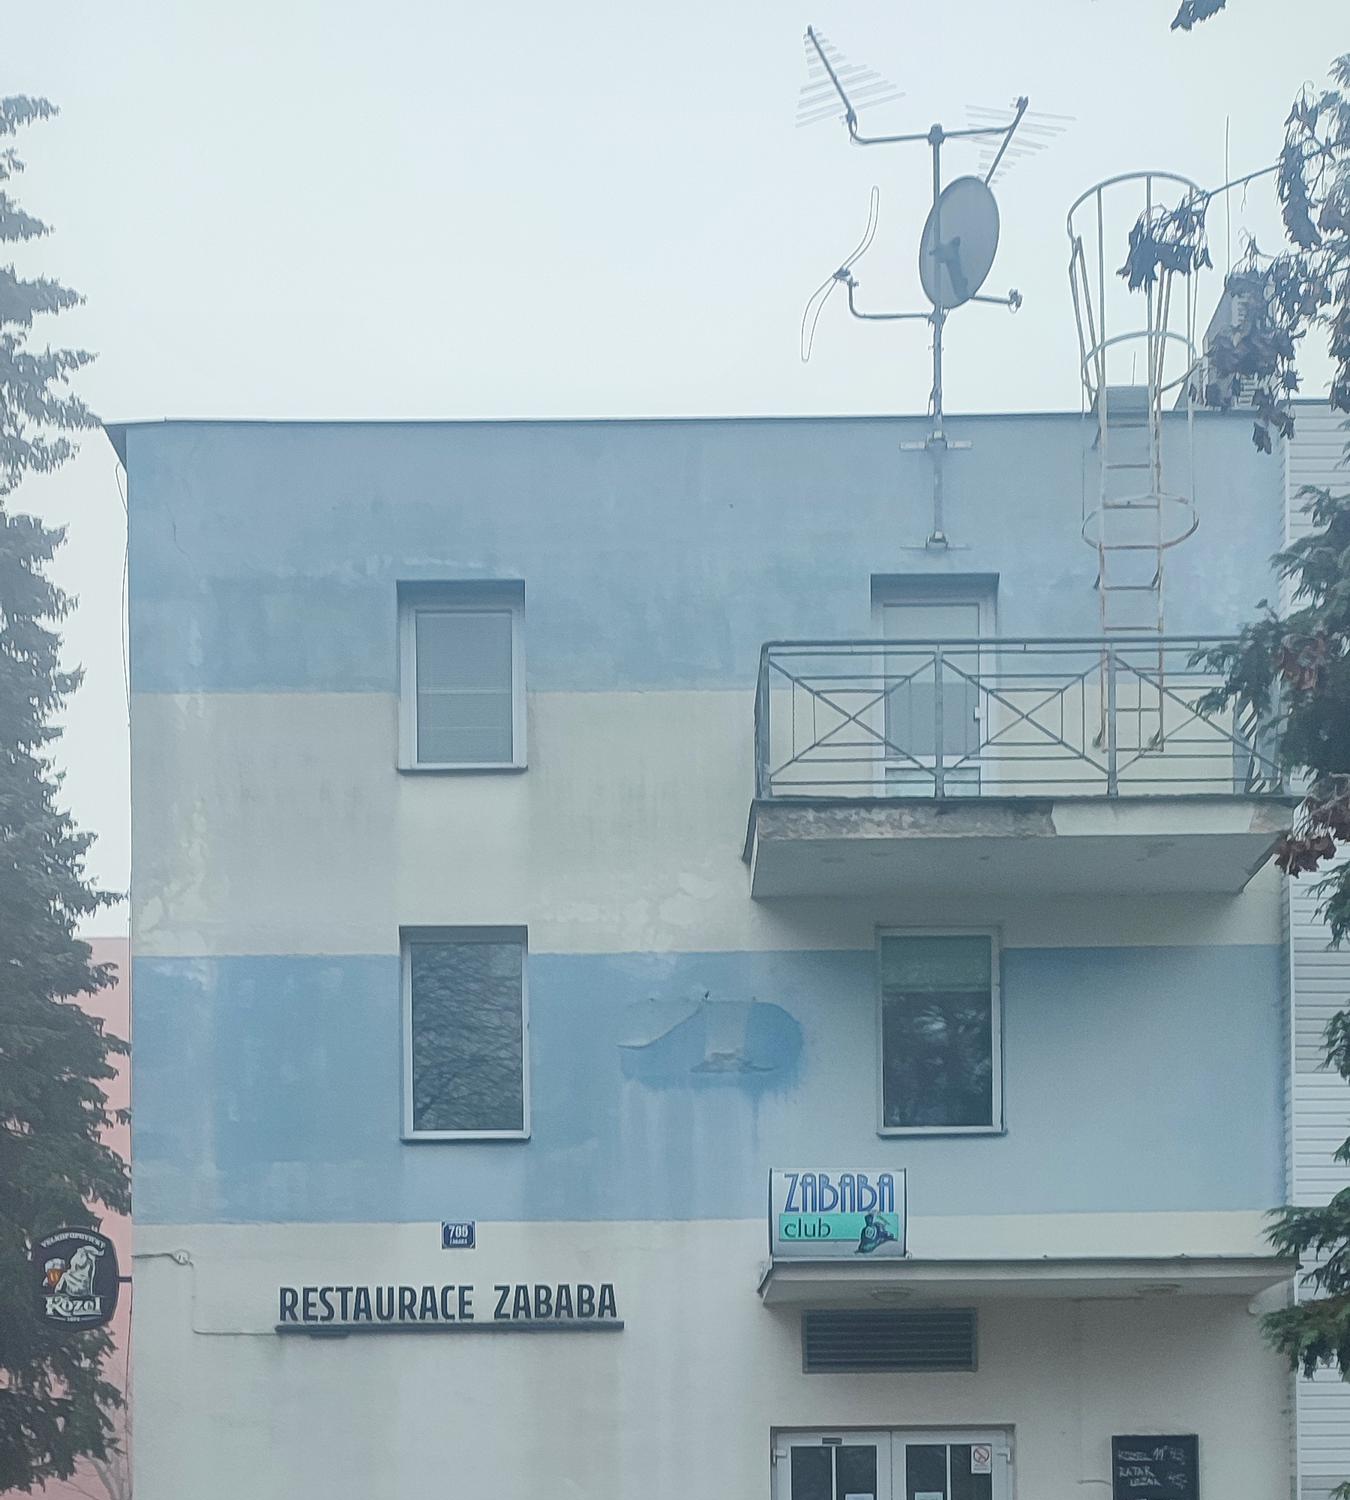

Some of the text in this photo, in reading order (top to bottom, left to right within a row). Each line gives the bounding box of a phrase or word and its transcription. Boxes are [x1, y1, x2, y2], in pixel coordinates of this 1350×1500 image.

[784, 1172, 895, 1213] ZABABA
[784, 1217, 831, 1238] club
[279, 1283, 618, 1322] RESTAURACE ZABABA
